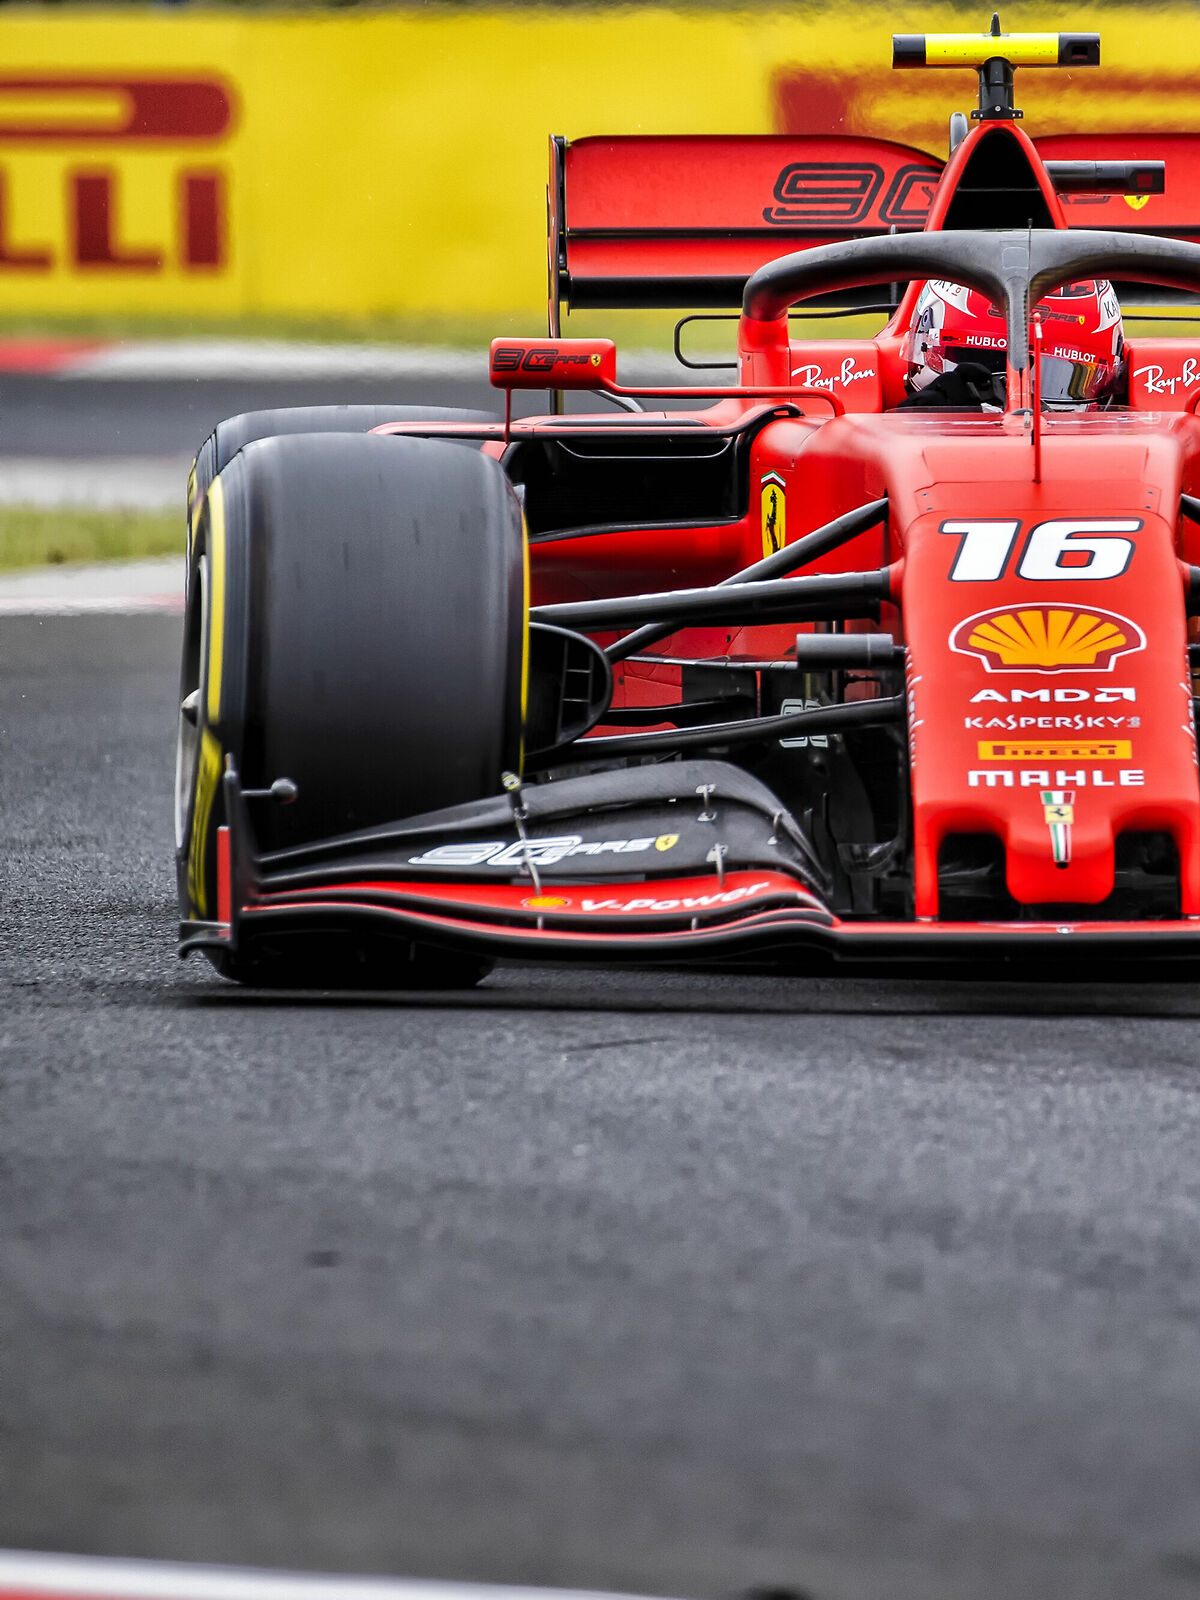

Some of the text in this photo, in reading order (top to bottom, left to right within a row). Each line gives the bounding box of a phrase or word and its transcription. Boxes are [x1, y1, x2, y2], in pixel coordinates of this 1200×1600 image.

[966, 335, 1007, 349] HUBLO
[1053, 346, 1096, 364] HUBLOT
[791, 357, 876, 392] Ray-Ban
[938, 517, 1144, 582] 16
[968, 687, 1091, 703] AMD
[964, 714, 1126, 731] KASPERSKY
[992, 745, 1118, 757] PIRELLI
[967, 769, 1145, 787] MAHLE
[581, 881, 770, 911] V-Power
